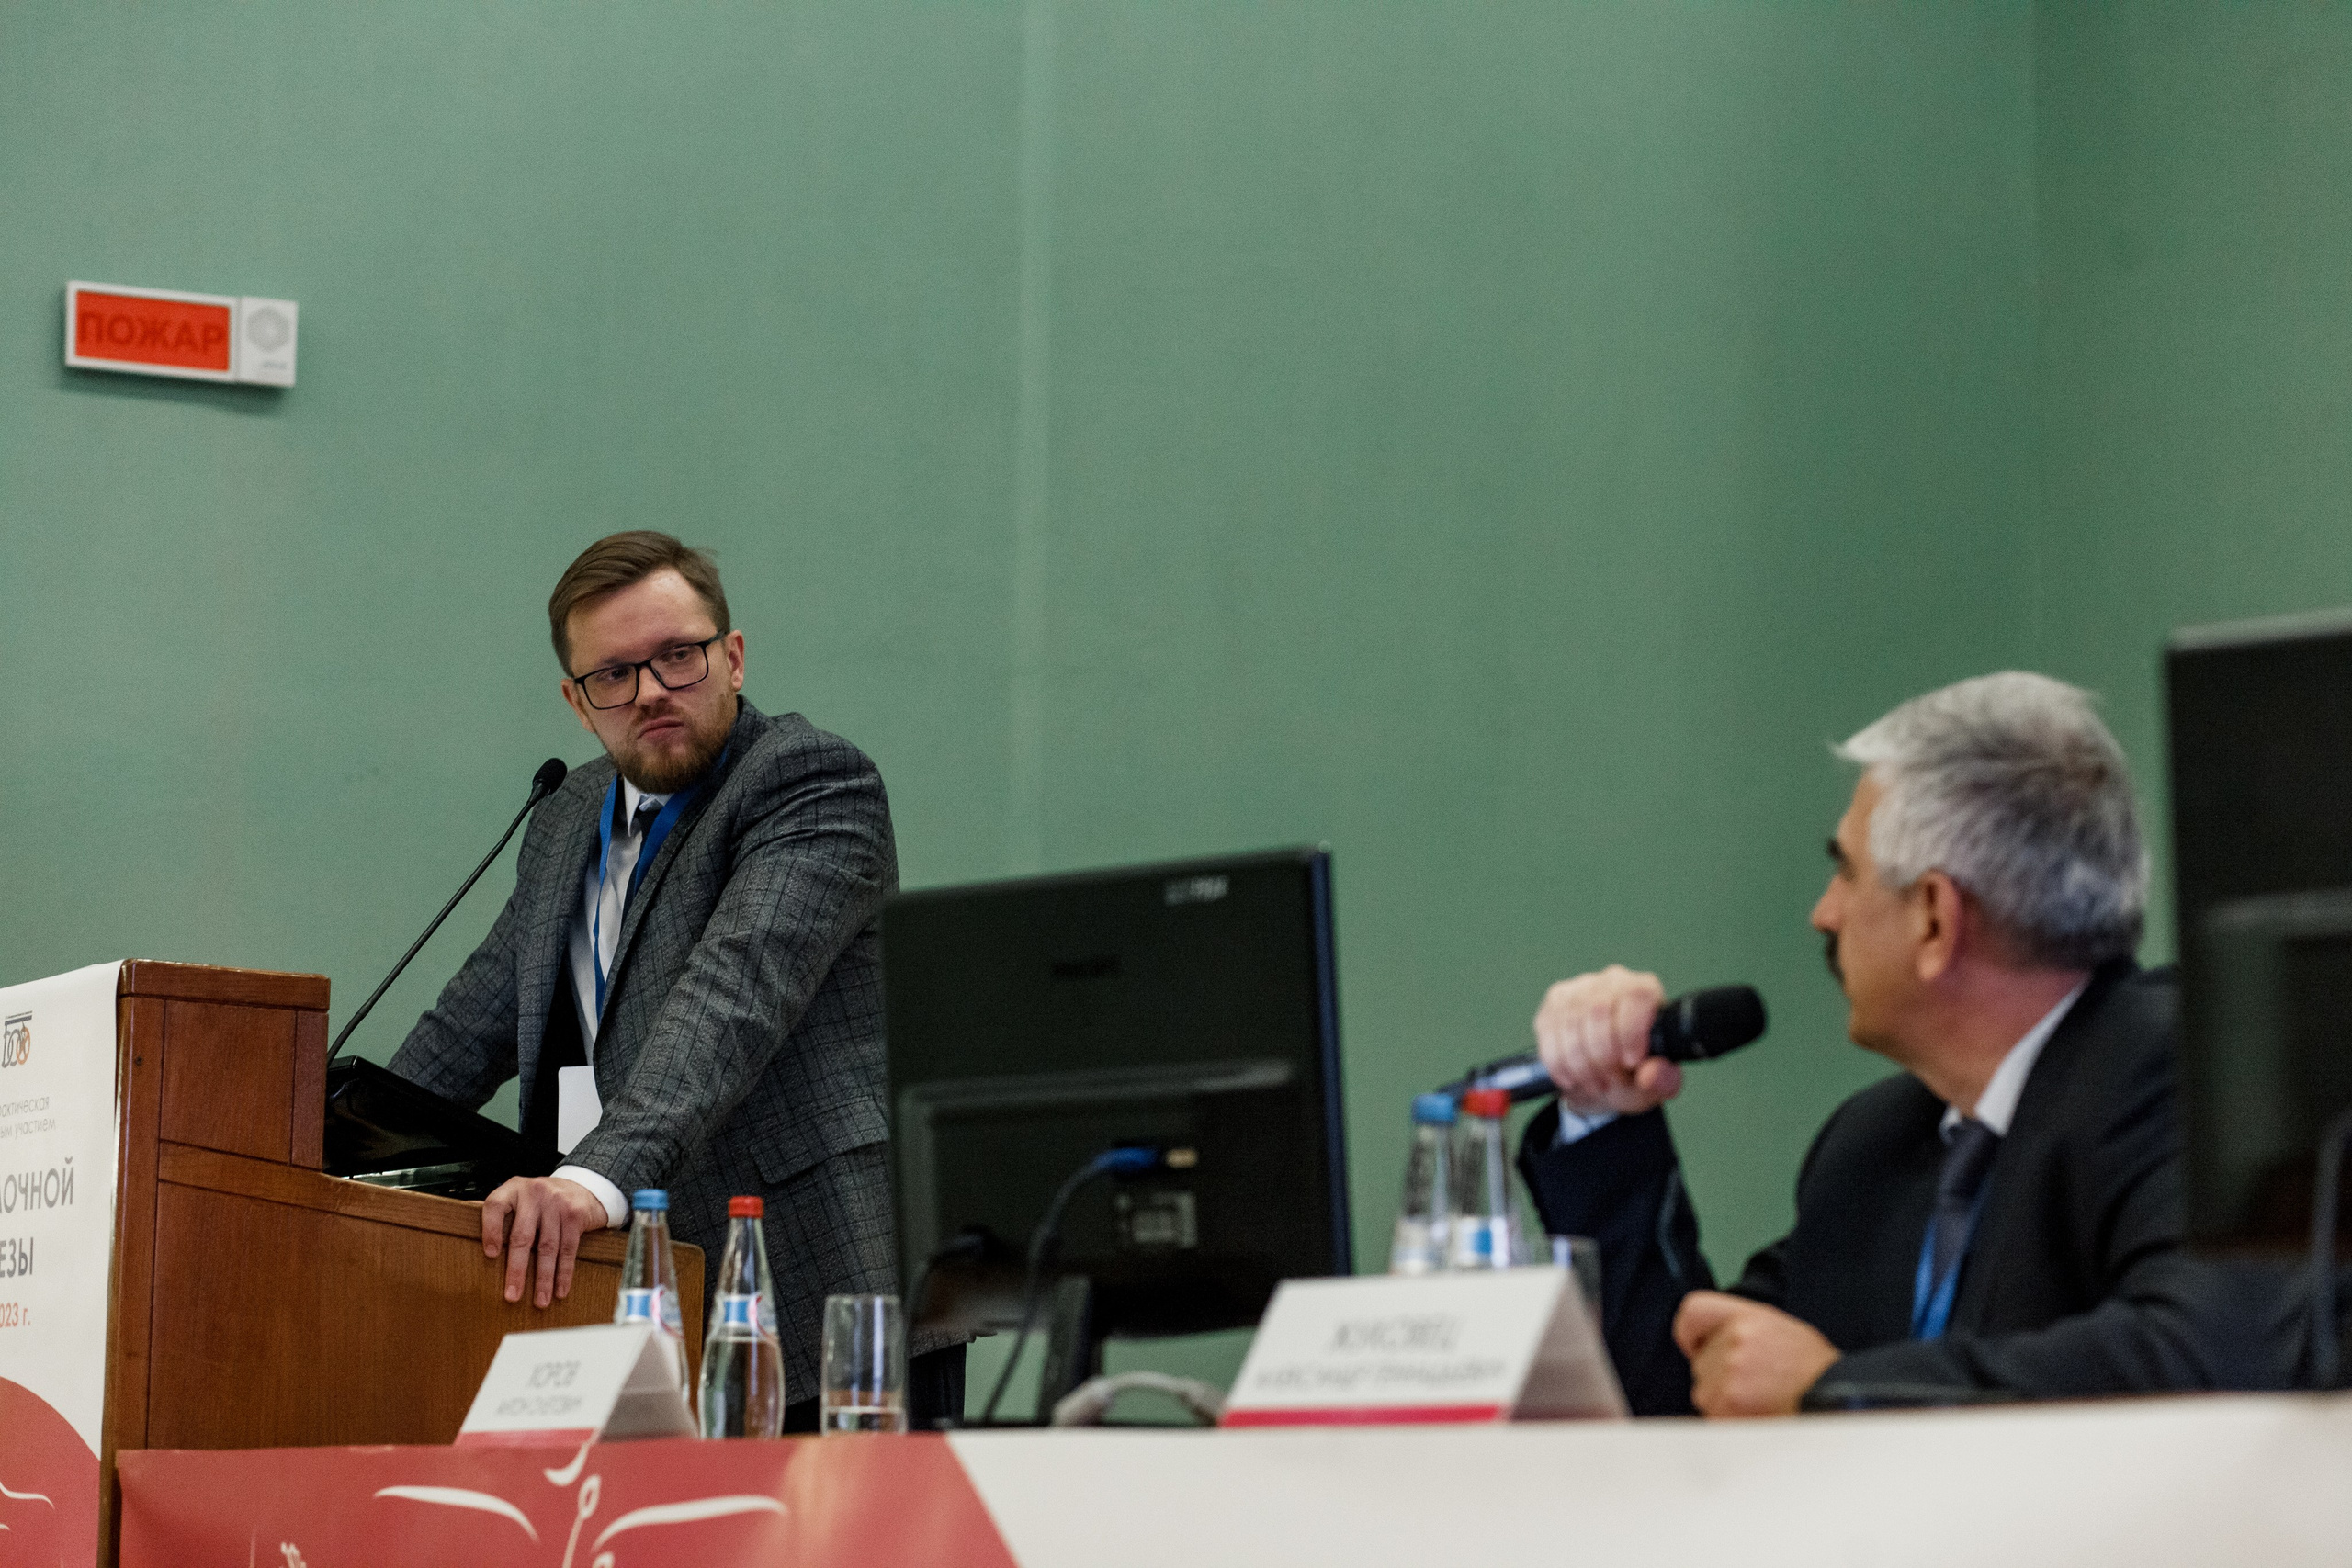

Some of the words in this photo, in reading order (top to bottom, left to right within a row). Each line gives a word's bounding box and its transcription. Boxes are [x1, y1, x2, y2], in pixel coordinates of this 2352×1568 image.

[78, 311, 225, 355] ПОЖАР
[0, 1096, 50, 1118] актическая
[15, 1117, 56, 1140] участием
[0, 1156, 74, 1214] ОЧНОЙ
